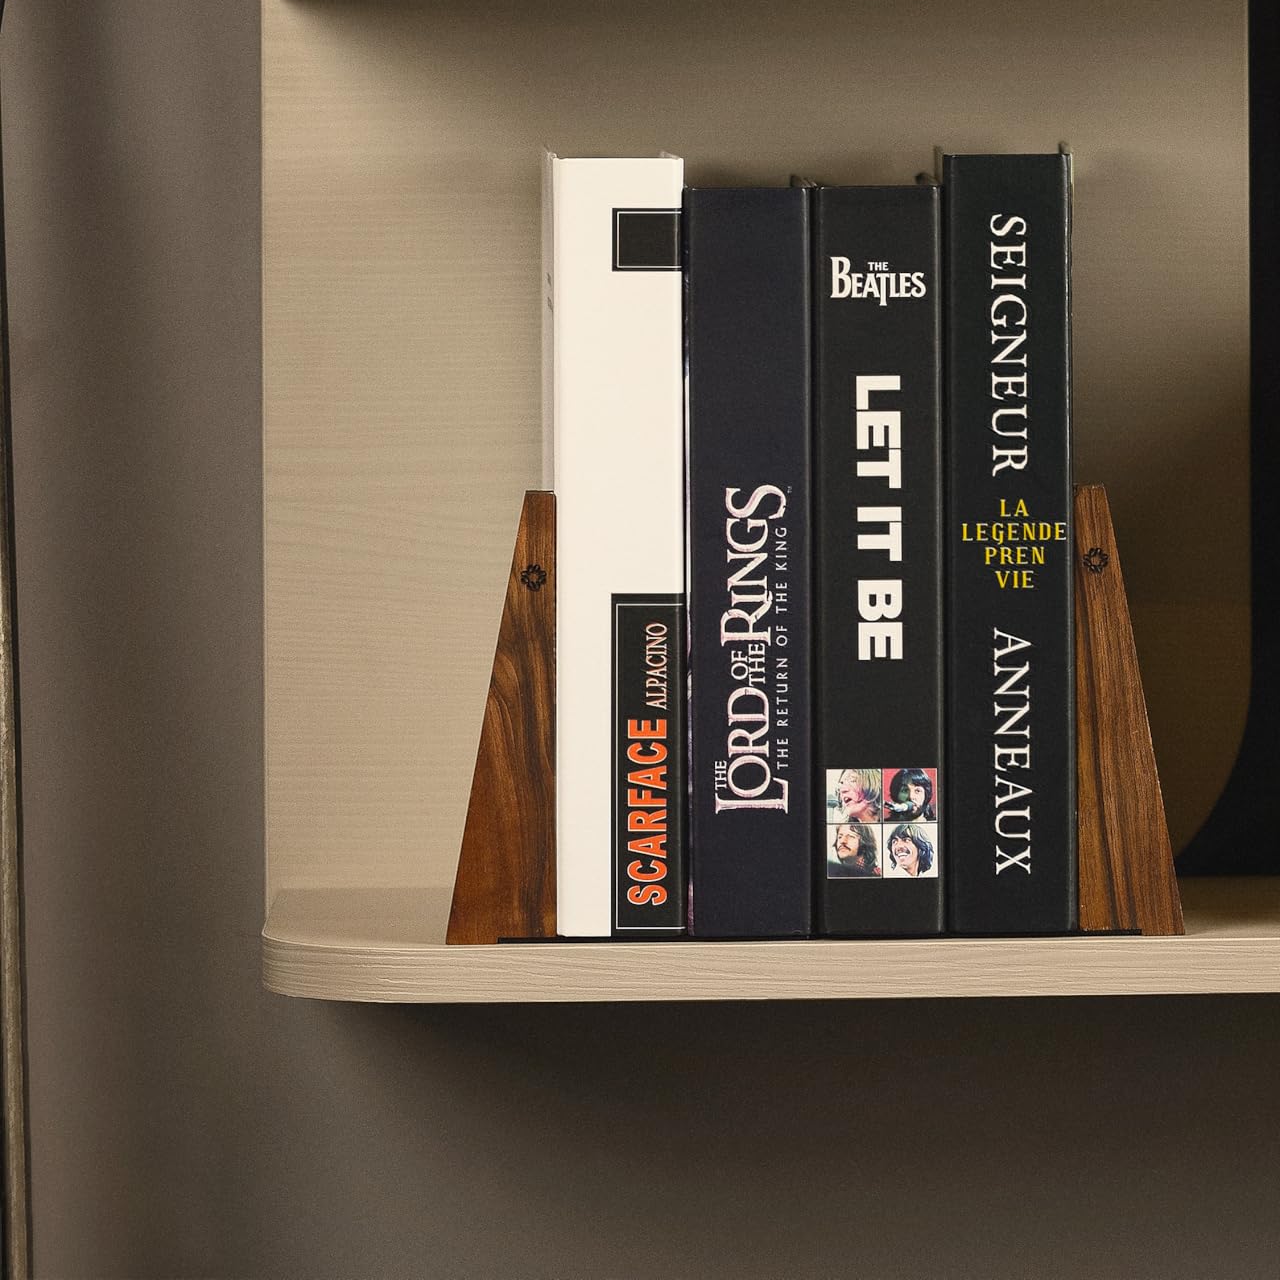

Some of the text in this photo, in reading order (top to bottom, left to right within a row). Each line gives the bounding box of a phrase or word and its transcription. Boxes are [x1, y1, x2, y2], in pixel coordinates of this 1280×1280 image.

[830, 256, 927, 306] BEATLES
[867, 261, 889, 271] THE
[989, 213, 1032, 477] SEIGNEUR
[854, 374, 904, 661] LET IT BE
[962, 522, 1067, 545] LEGENDE
[1000, 499, 1029, 517] LA
[985, 546, 1045, 565] PREN
[995, 570, 1034, 589] VIE
[646, 622, 668, 710] ALPACINO
[714, 484, 789, 814] THE LORD OF THE RINGS
[775, 526, 790, 770] THE RETURN OF THE KING
[993, 626, 1033, 875] ANNEAUX
[626, 718, 668, 906] SCARFACE
